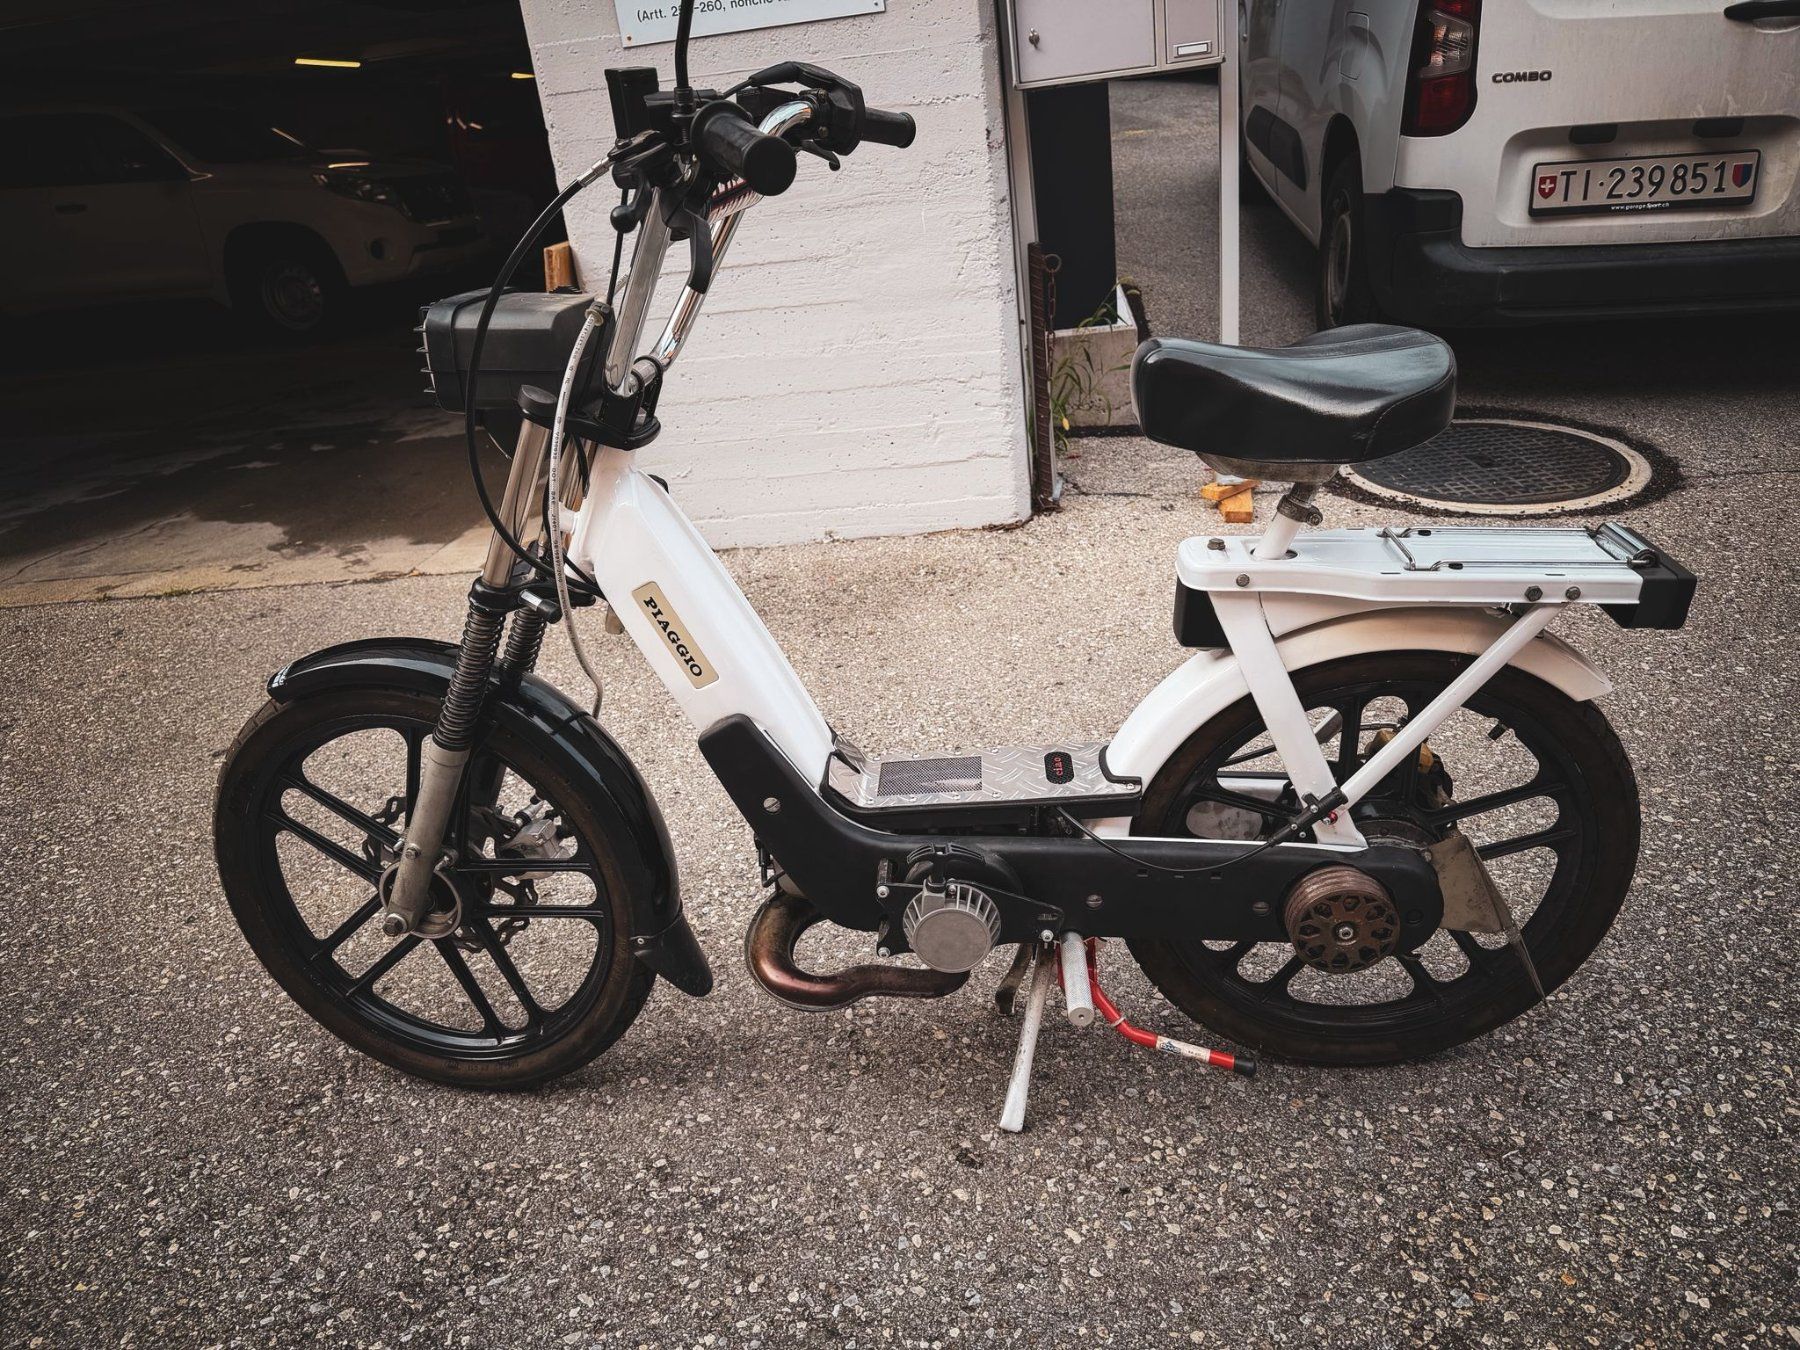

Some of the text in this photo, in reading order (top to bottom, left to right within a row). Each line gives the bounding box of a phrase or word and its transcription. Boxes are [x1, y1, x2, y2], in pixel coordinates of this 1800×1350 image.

[637, 9, 667, 23] (Artt.
[671, 0, 726, 17] 2-260,
[1491, 69, 1552, 83] COMBO
[643, 596, 702, 677] PIAGGIO
